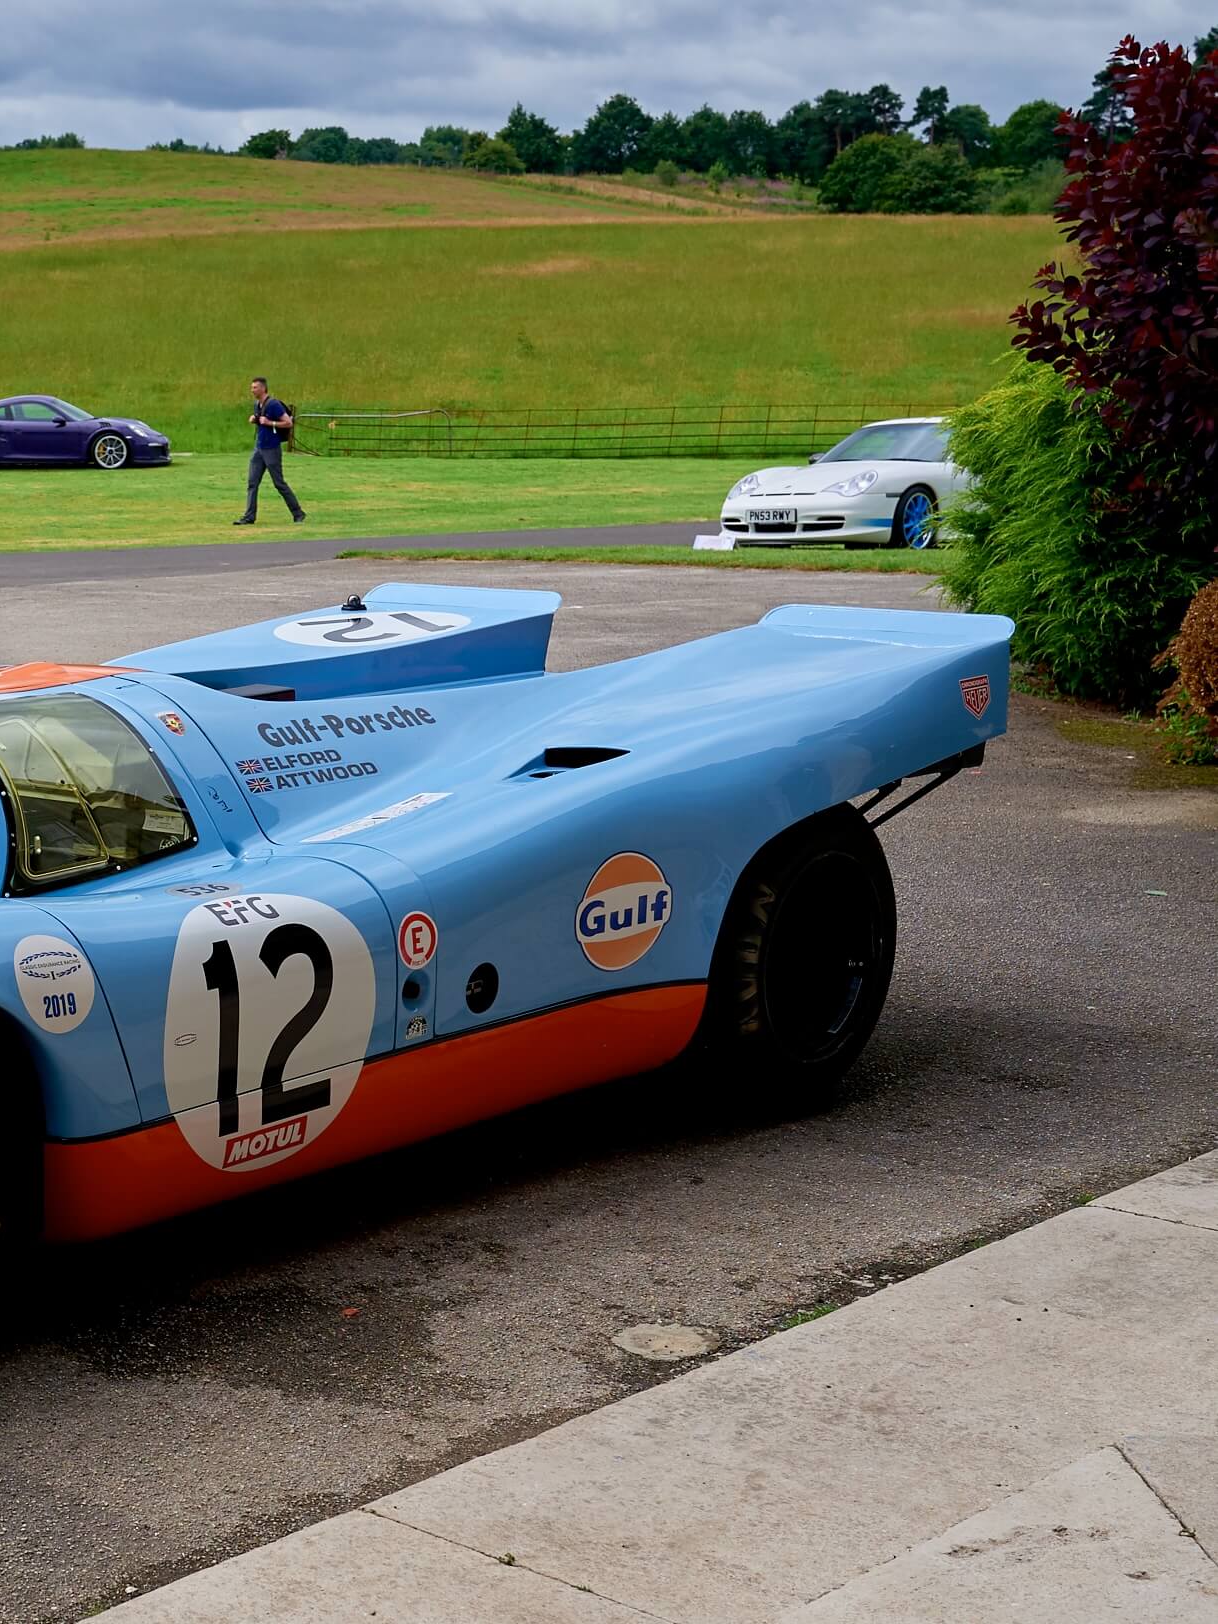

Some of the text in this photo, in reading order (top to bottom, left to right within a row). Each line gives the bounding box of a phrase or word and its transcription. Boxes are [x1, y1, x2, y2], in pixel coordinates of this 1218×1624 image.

[749, 510, 791, 521] PN53 RWY
[297, 612, 455, 643] 12
[965, 687, 988, 711] HEUER
[257, 705, 436, 747] Gulf-Porsche
[262, 749, 342, 772] ELFORD
[276, 762, 378, 789] ATTWOOD
[175, 884, 230, 896] 536
[203, 896, 280, 926] EFG
[579, 890, 668, 937] Gulf
[411, 926, 424, 955] E
[38, 960, 63, 969] ENDURANCE
[43, 993, 77, 1018] 2019
[202, 922, 333, 1138] 12
[227, 1123, 301, 1163] MOTUL
